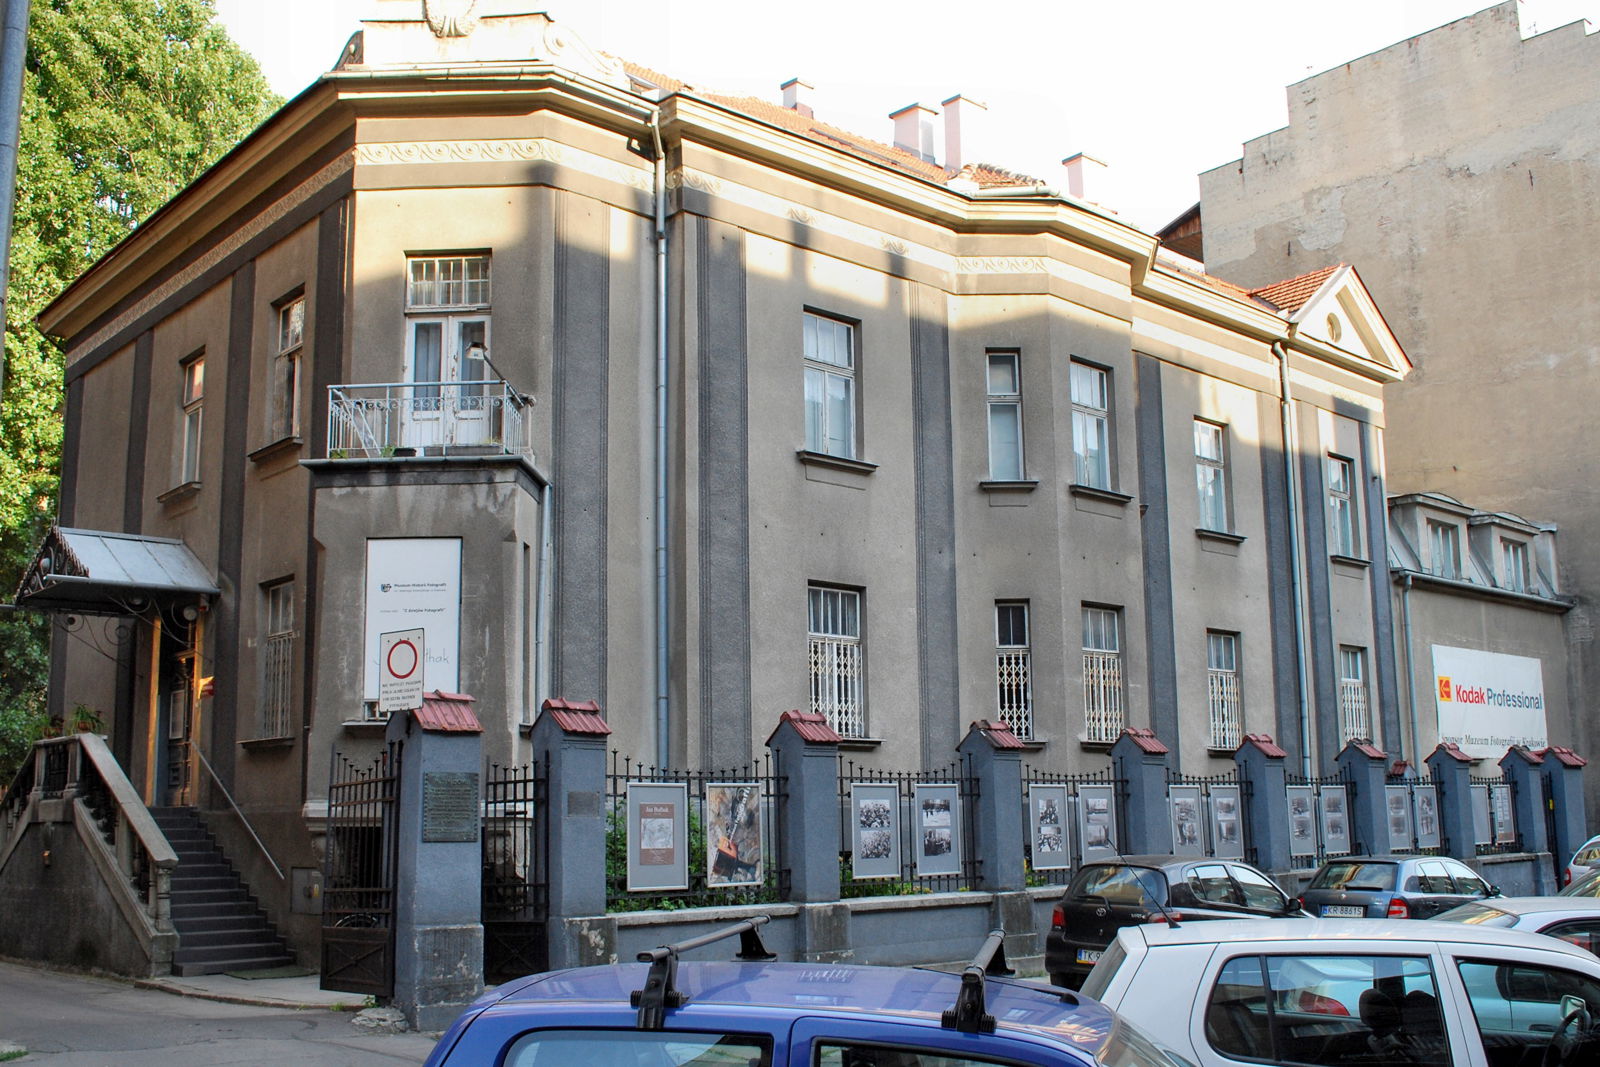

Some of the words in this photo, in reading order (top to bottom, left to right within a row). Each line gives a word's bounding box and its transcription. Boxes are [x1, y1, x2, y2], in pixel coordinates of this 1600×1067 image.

[1455, 684, 1486, 705] Kodak
[1486, 687, 1543, 710] Professional
[1465, 734, 1489, 746] Muzeum
[1328, 906, 1338, 915] KR
[1083, 950, 1094, 961] TK
